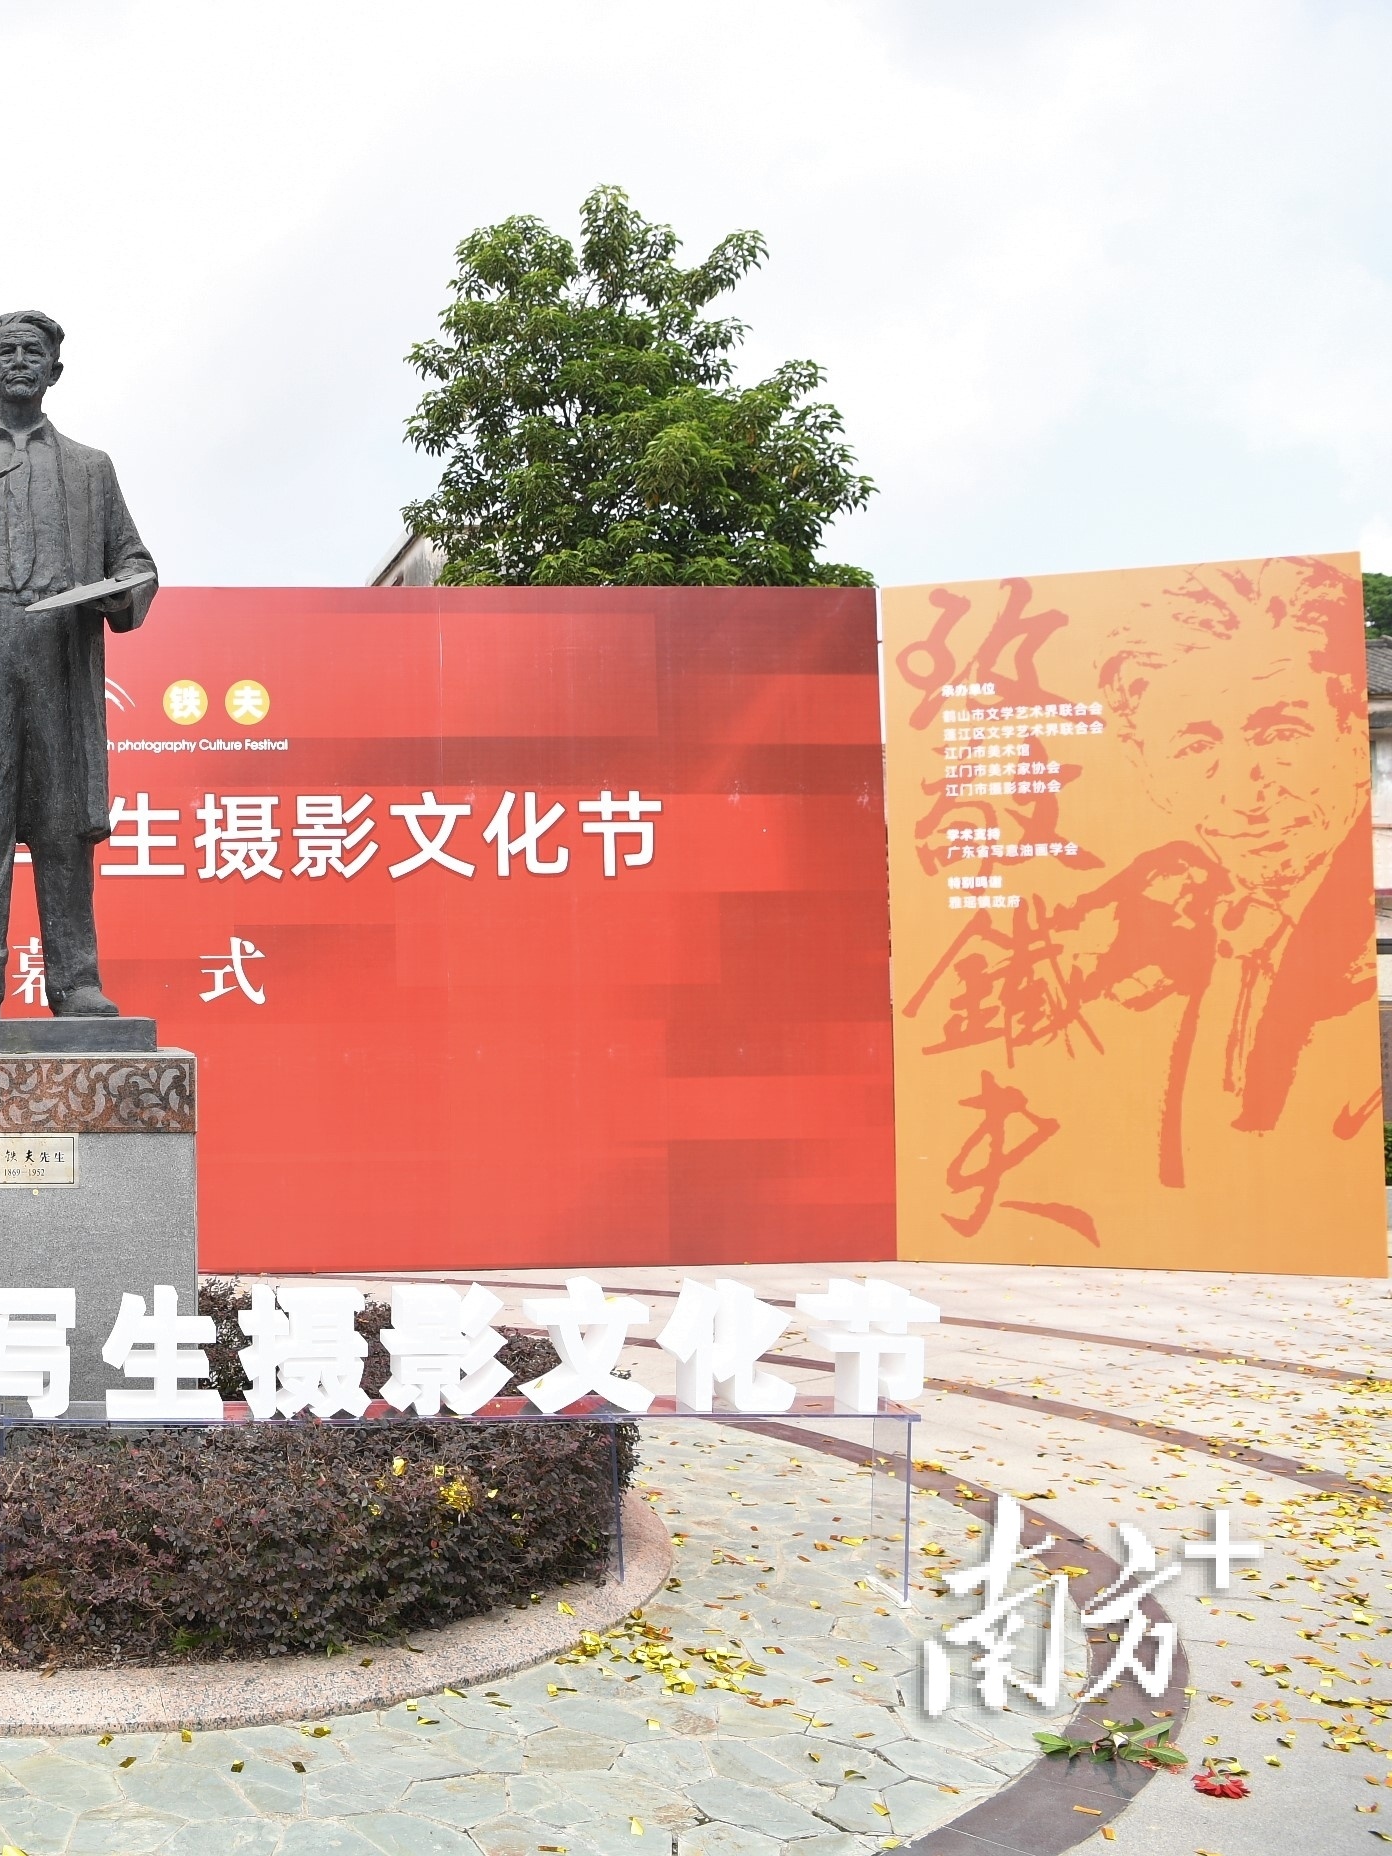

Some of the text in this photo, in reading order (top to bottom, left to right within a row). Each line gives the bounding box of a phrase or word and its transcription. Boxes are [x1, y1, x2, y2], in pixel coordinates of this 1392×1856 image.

[941, 682, 995, 697] 承办单位
[169, 686, 263, 718] 铁夫
[943, 702, 1103, 723] 鹤山市文学艺术界联合会
[117, 739, 196, 753] photography
[199, 739, 242, 751] Culture
[245, 738, 288, 751] Festival
[944, 743, 1030, 760] 江门市美术馆
[945, 760, 1060, 778] 江门市美术家协会
[945, 780, 1062, 797] 江门市摄影家协会
[946, 828, 1001, 842] 学术支持
[947, 842, 1078, 859] 广东省写意油画学会
